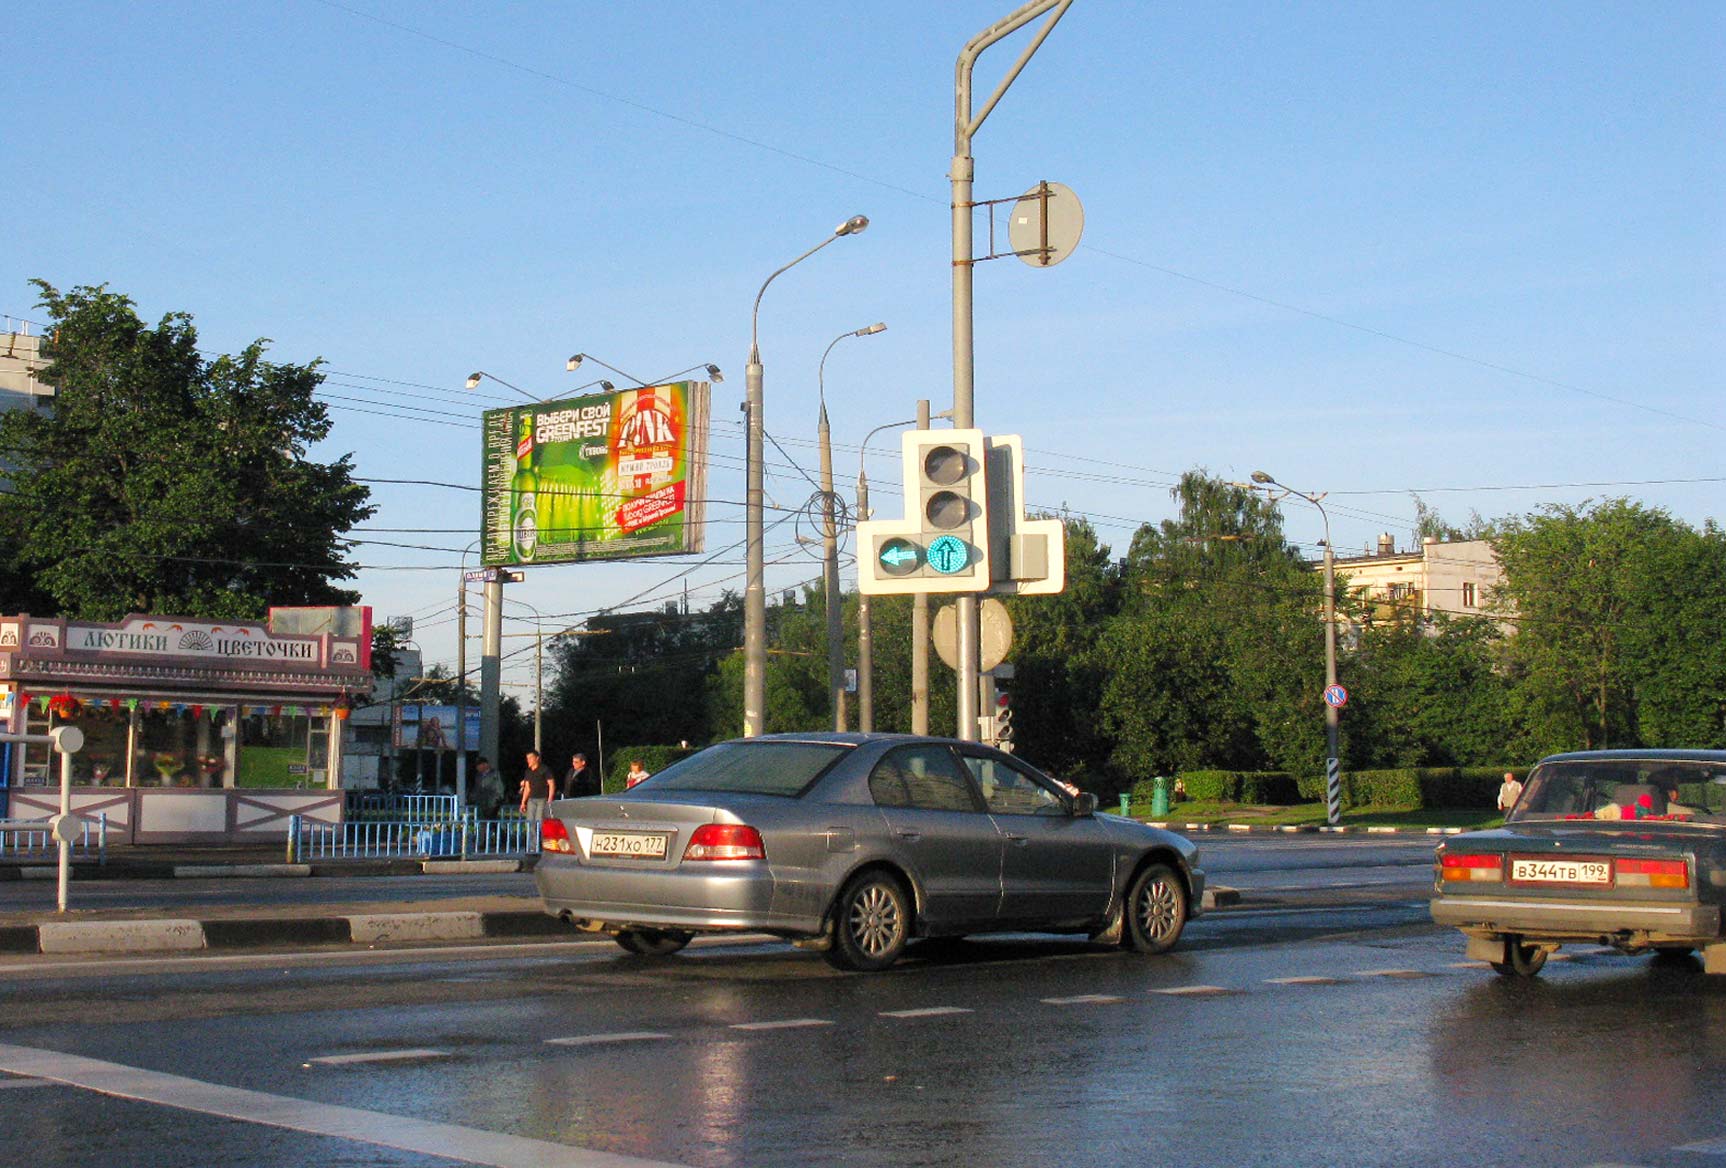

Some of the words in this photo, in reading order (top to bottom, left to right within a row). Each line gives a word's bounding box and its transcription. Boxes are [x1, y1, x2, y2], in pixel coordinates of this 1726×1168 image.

[536, 408, 580, 426] ВЫБЕРИ
[581, 402, 611, 420] СВОЙ
[536, 417, 611, 444] GREENFEST
[83, 630, 168, 651] ЛЮТИКИ
[217, 638, 313, 658] ЦВЕТОЧКИ
[645, 837, 662, 849] 177
[1518, 863, 1577, 879] В344ТВ
[1582, 865, 1605, 877] 199
